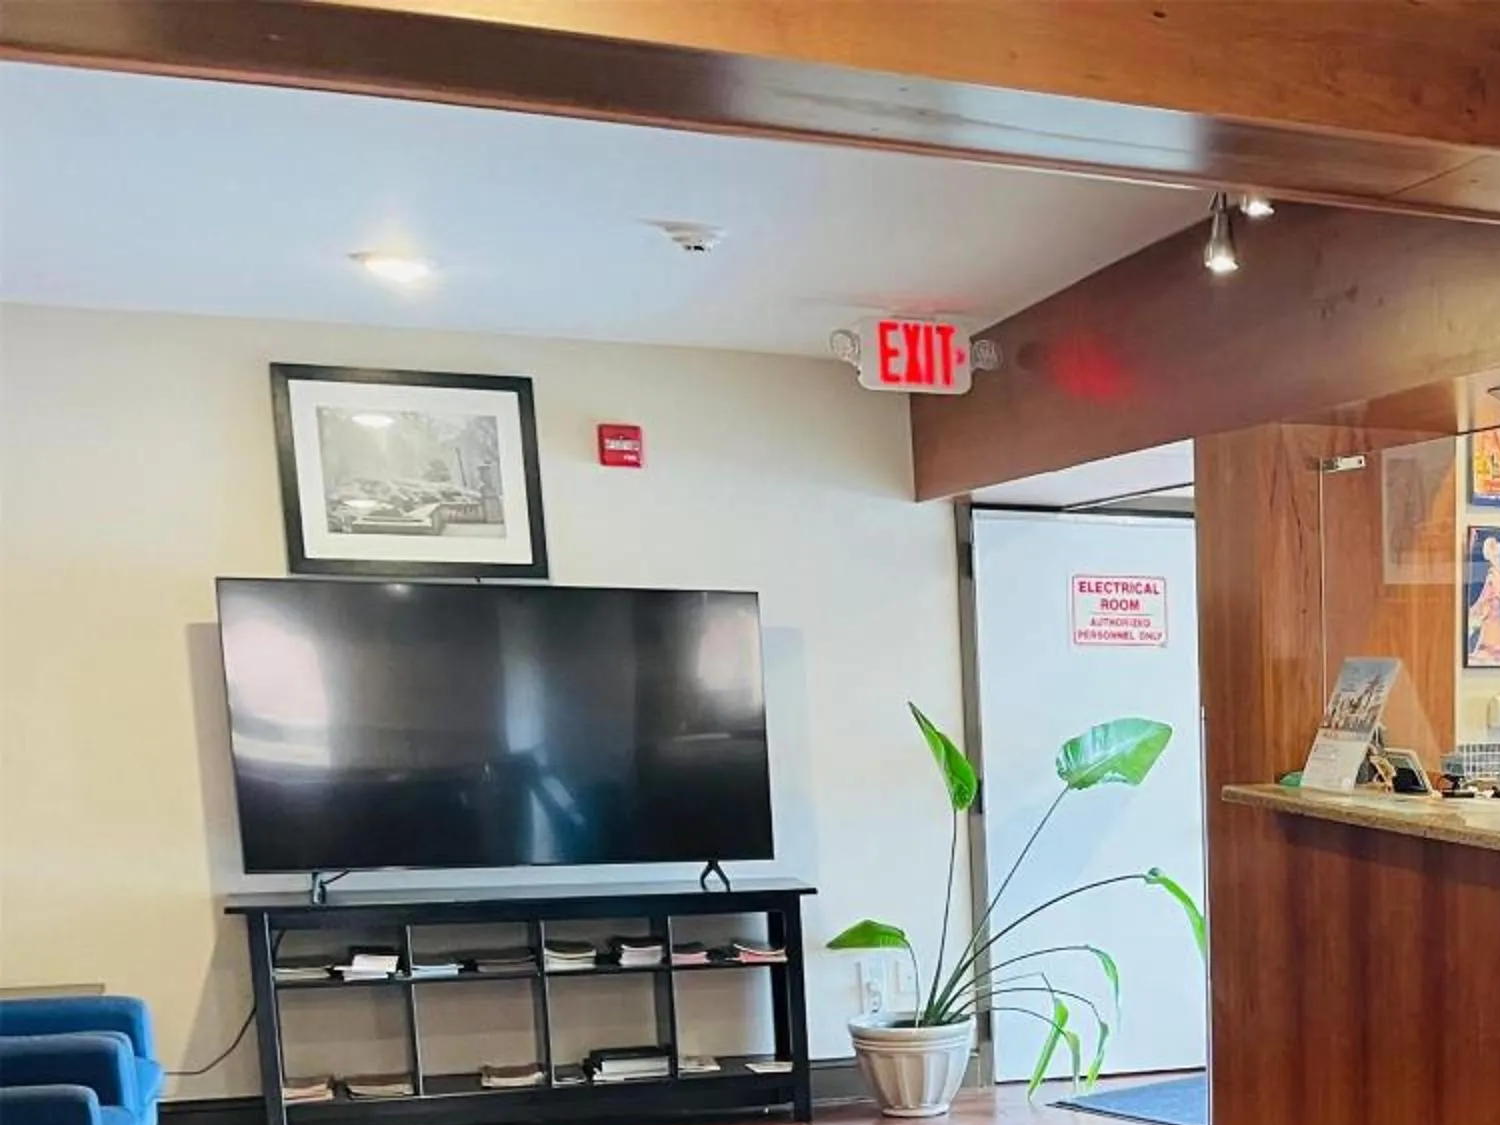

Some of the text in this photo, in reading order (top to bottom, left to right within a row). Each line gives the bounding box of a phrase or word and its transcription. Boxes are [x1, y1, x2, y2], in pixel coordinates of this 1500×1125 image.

[878, 321, 955, 385] EXIT
[1078, 581, 1160, 595] ELECTRICAL
[1100, 598, 1140, 611] ROOM
